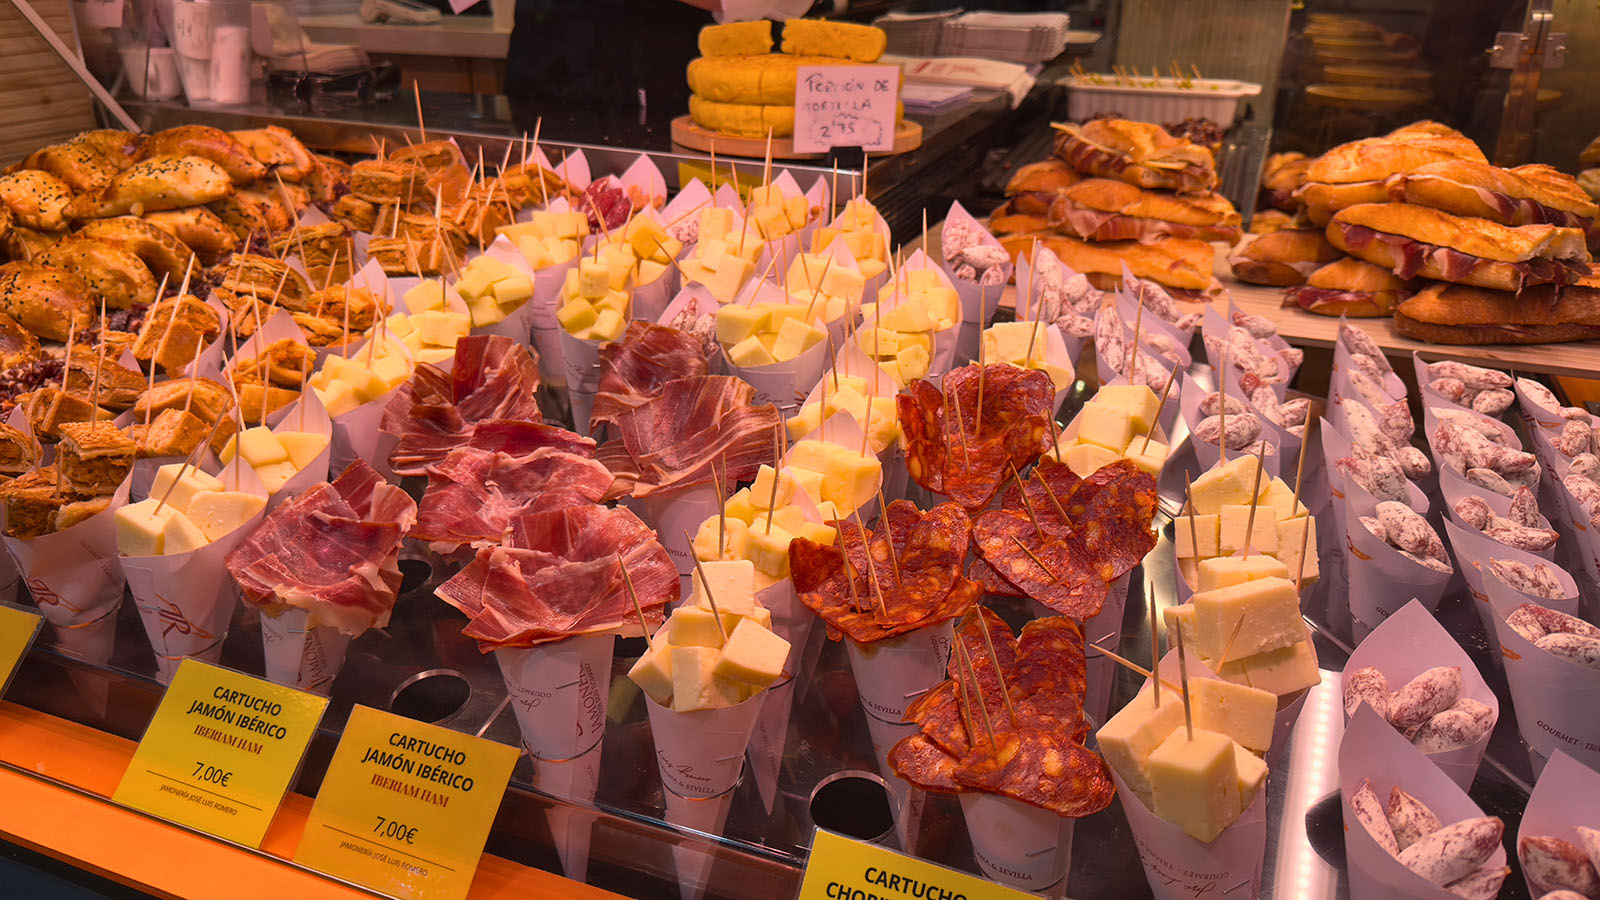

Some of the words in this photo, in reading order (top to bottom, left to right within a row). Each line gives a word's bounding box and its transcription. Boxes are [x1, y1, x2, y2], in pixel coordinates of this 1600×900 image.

[874, 80, 889, 92] DE
[213, 686, 282, 717] CARTUCHO
[874, 704, 902, 716] SEVILLA
[187, 700, 236, 725] JAMÓN
[235, 713, 287, 740] IBÉRICO
[1536, 720, 1579, 745] GOURMET
[193, 724, 237, 748] IBERIAM
[236, 739, 264, 755] HAM
[389, 733, 466, 765] CARTUCHO
[192, 762, 233, 787] 7,00€
[361, 747, 415, 774] JAMÓN
[415, 763, 474, 792] IBÉRICO
[160, 784, 189, 799] JAMONERÍA
[188, 792, 203, 803] JOSÉ
[202, 797, 215, 808] LUIS
[214, 802, 238, 816] ROMERO
[371, 774, 421, 798] IBERIAM
[420, 790, 450, 808] HAM
[685, 784, 716, 794] SEVILLA
[373, 816, 419, 844] 7,00€
[339, 841, 373, 858] JAMONERÍA
[371, 851, 387, 863] JOSÉ
[387, 857, 401, 867] LUIS
[400, 861, 428, 877] ROMERO
[999, 868, 1032, 880] SEVILLA
[1184, 871, 1229, 880] GOURMET
